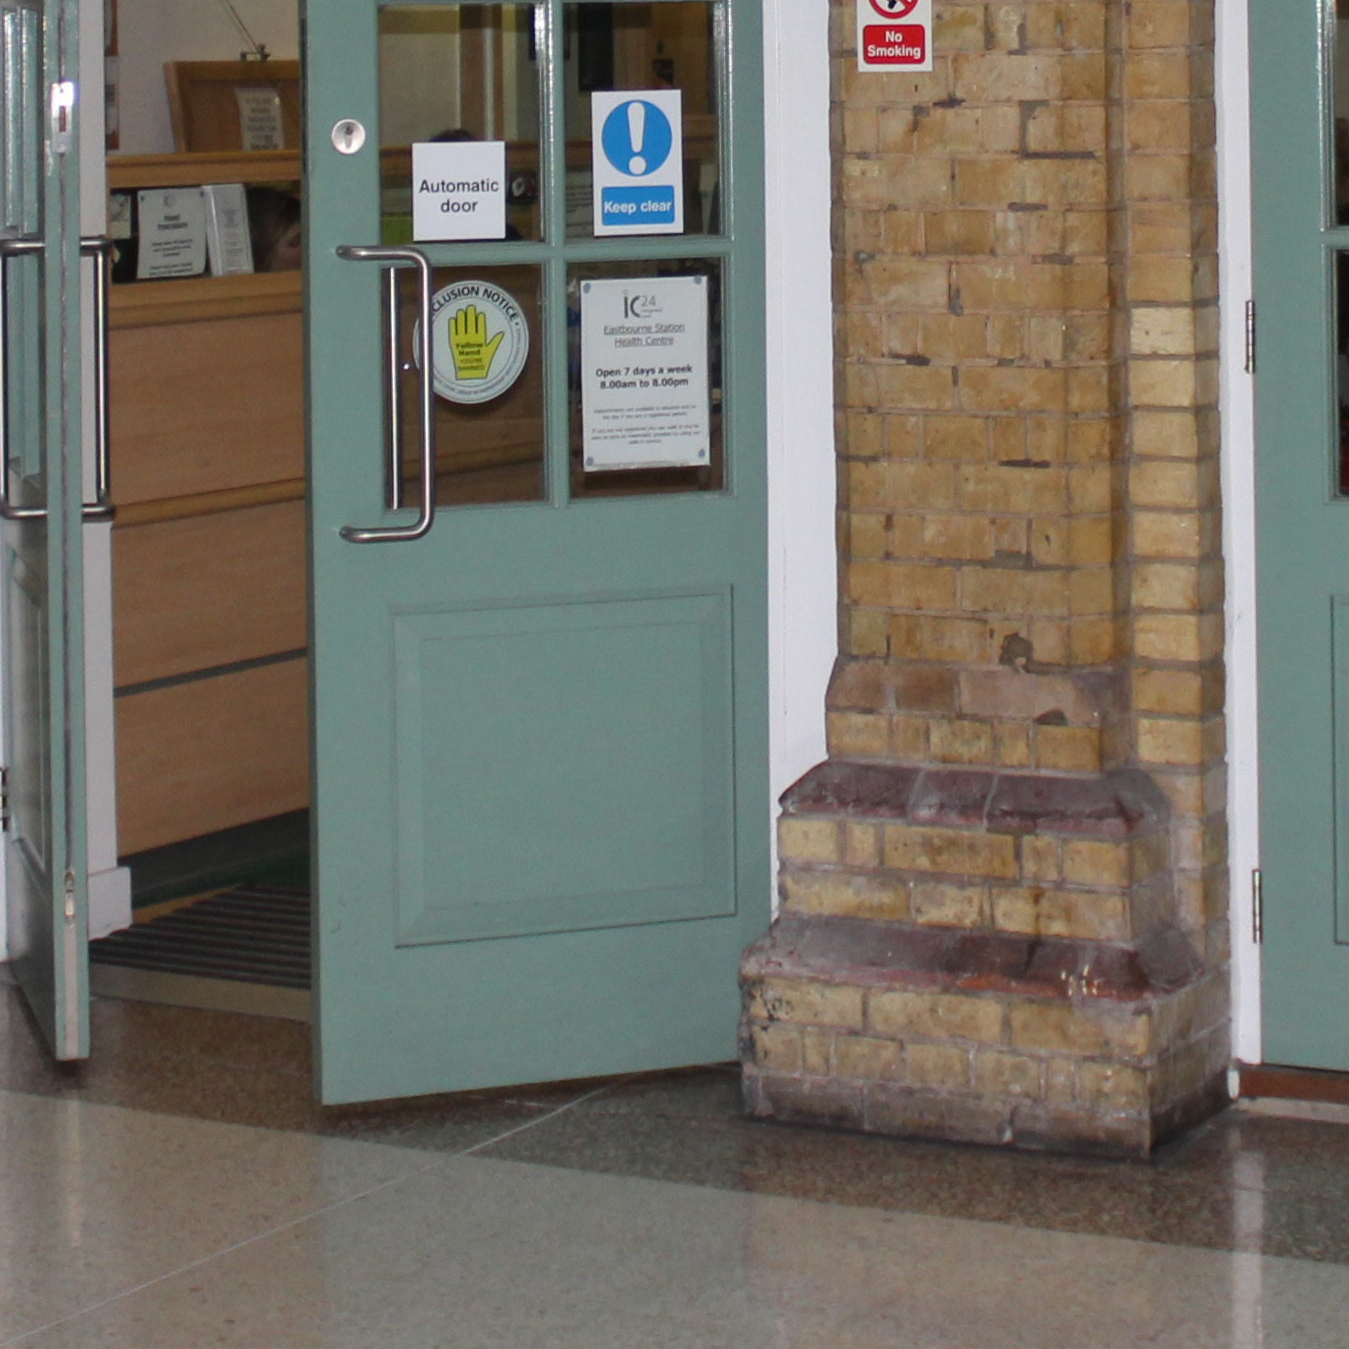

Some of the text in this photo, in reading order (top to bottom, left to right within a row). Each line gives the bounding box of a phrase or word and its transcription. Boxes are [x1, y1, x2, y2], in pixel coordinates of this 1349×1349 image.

[885, 31, 903, 42] No
[867, 45, 921, 59] Smoking
[419, 178, 499, 193] Automatic
[440, 199, 478, 213] door
[604, 200, 672, 215] Keep clear
[432, 286, 517, 323] CLUSION NOTICE
[603, 323, 685, 336] Eastbourne Station
[614, 336, 674, 348] Health Centre
[596, 368, 621, 378] Open
[624, 367, 630, 376] 7
[633, 367, 656, 377] days
[667, 364, 693, 373] week
[600, 378, 689, 389] 8.00am to 8.00pm
